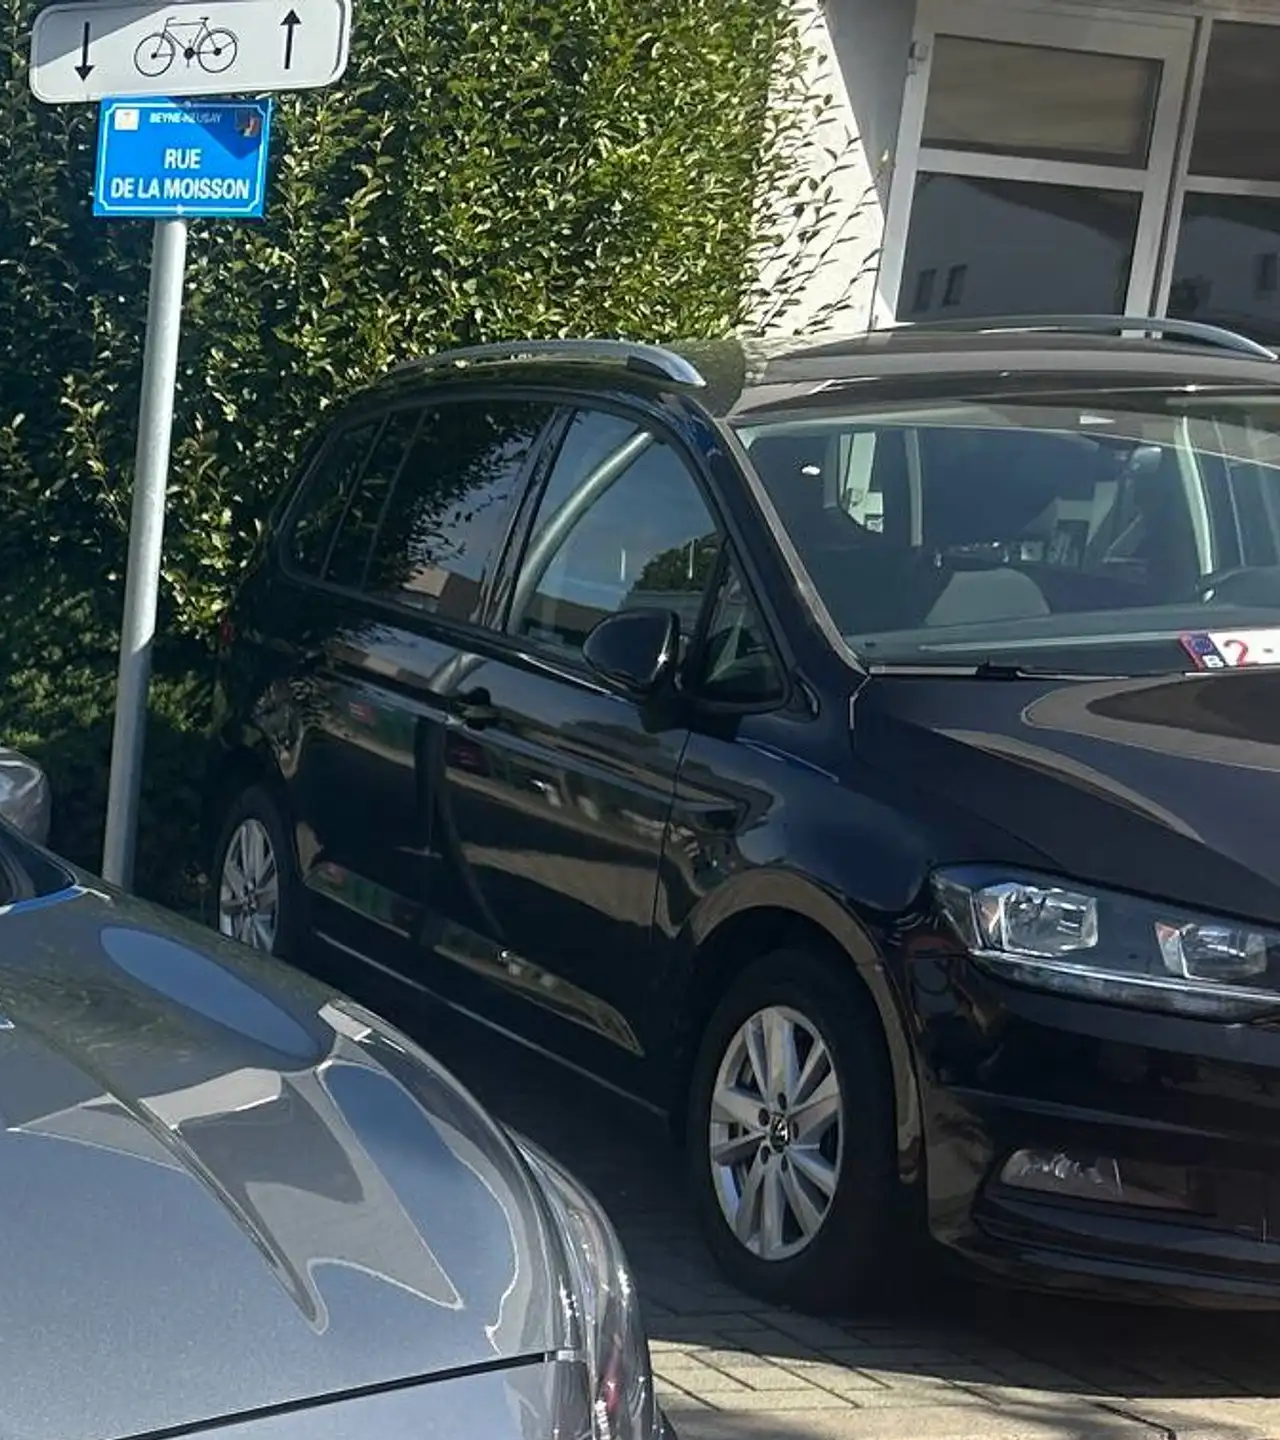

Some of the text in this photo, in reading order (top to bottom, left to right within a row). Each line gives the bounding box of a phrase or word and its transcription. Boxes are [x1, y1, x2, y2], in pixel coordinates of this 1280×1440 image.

[164, 148, 201, 169] RUE
[111, 178, 249, 200] DE LA MOISSON
